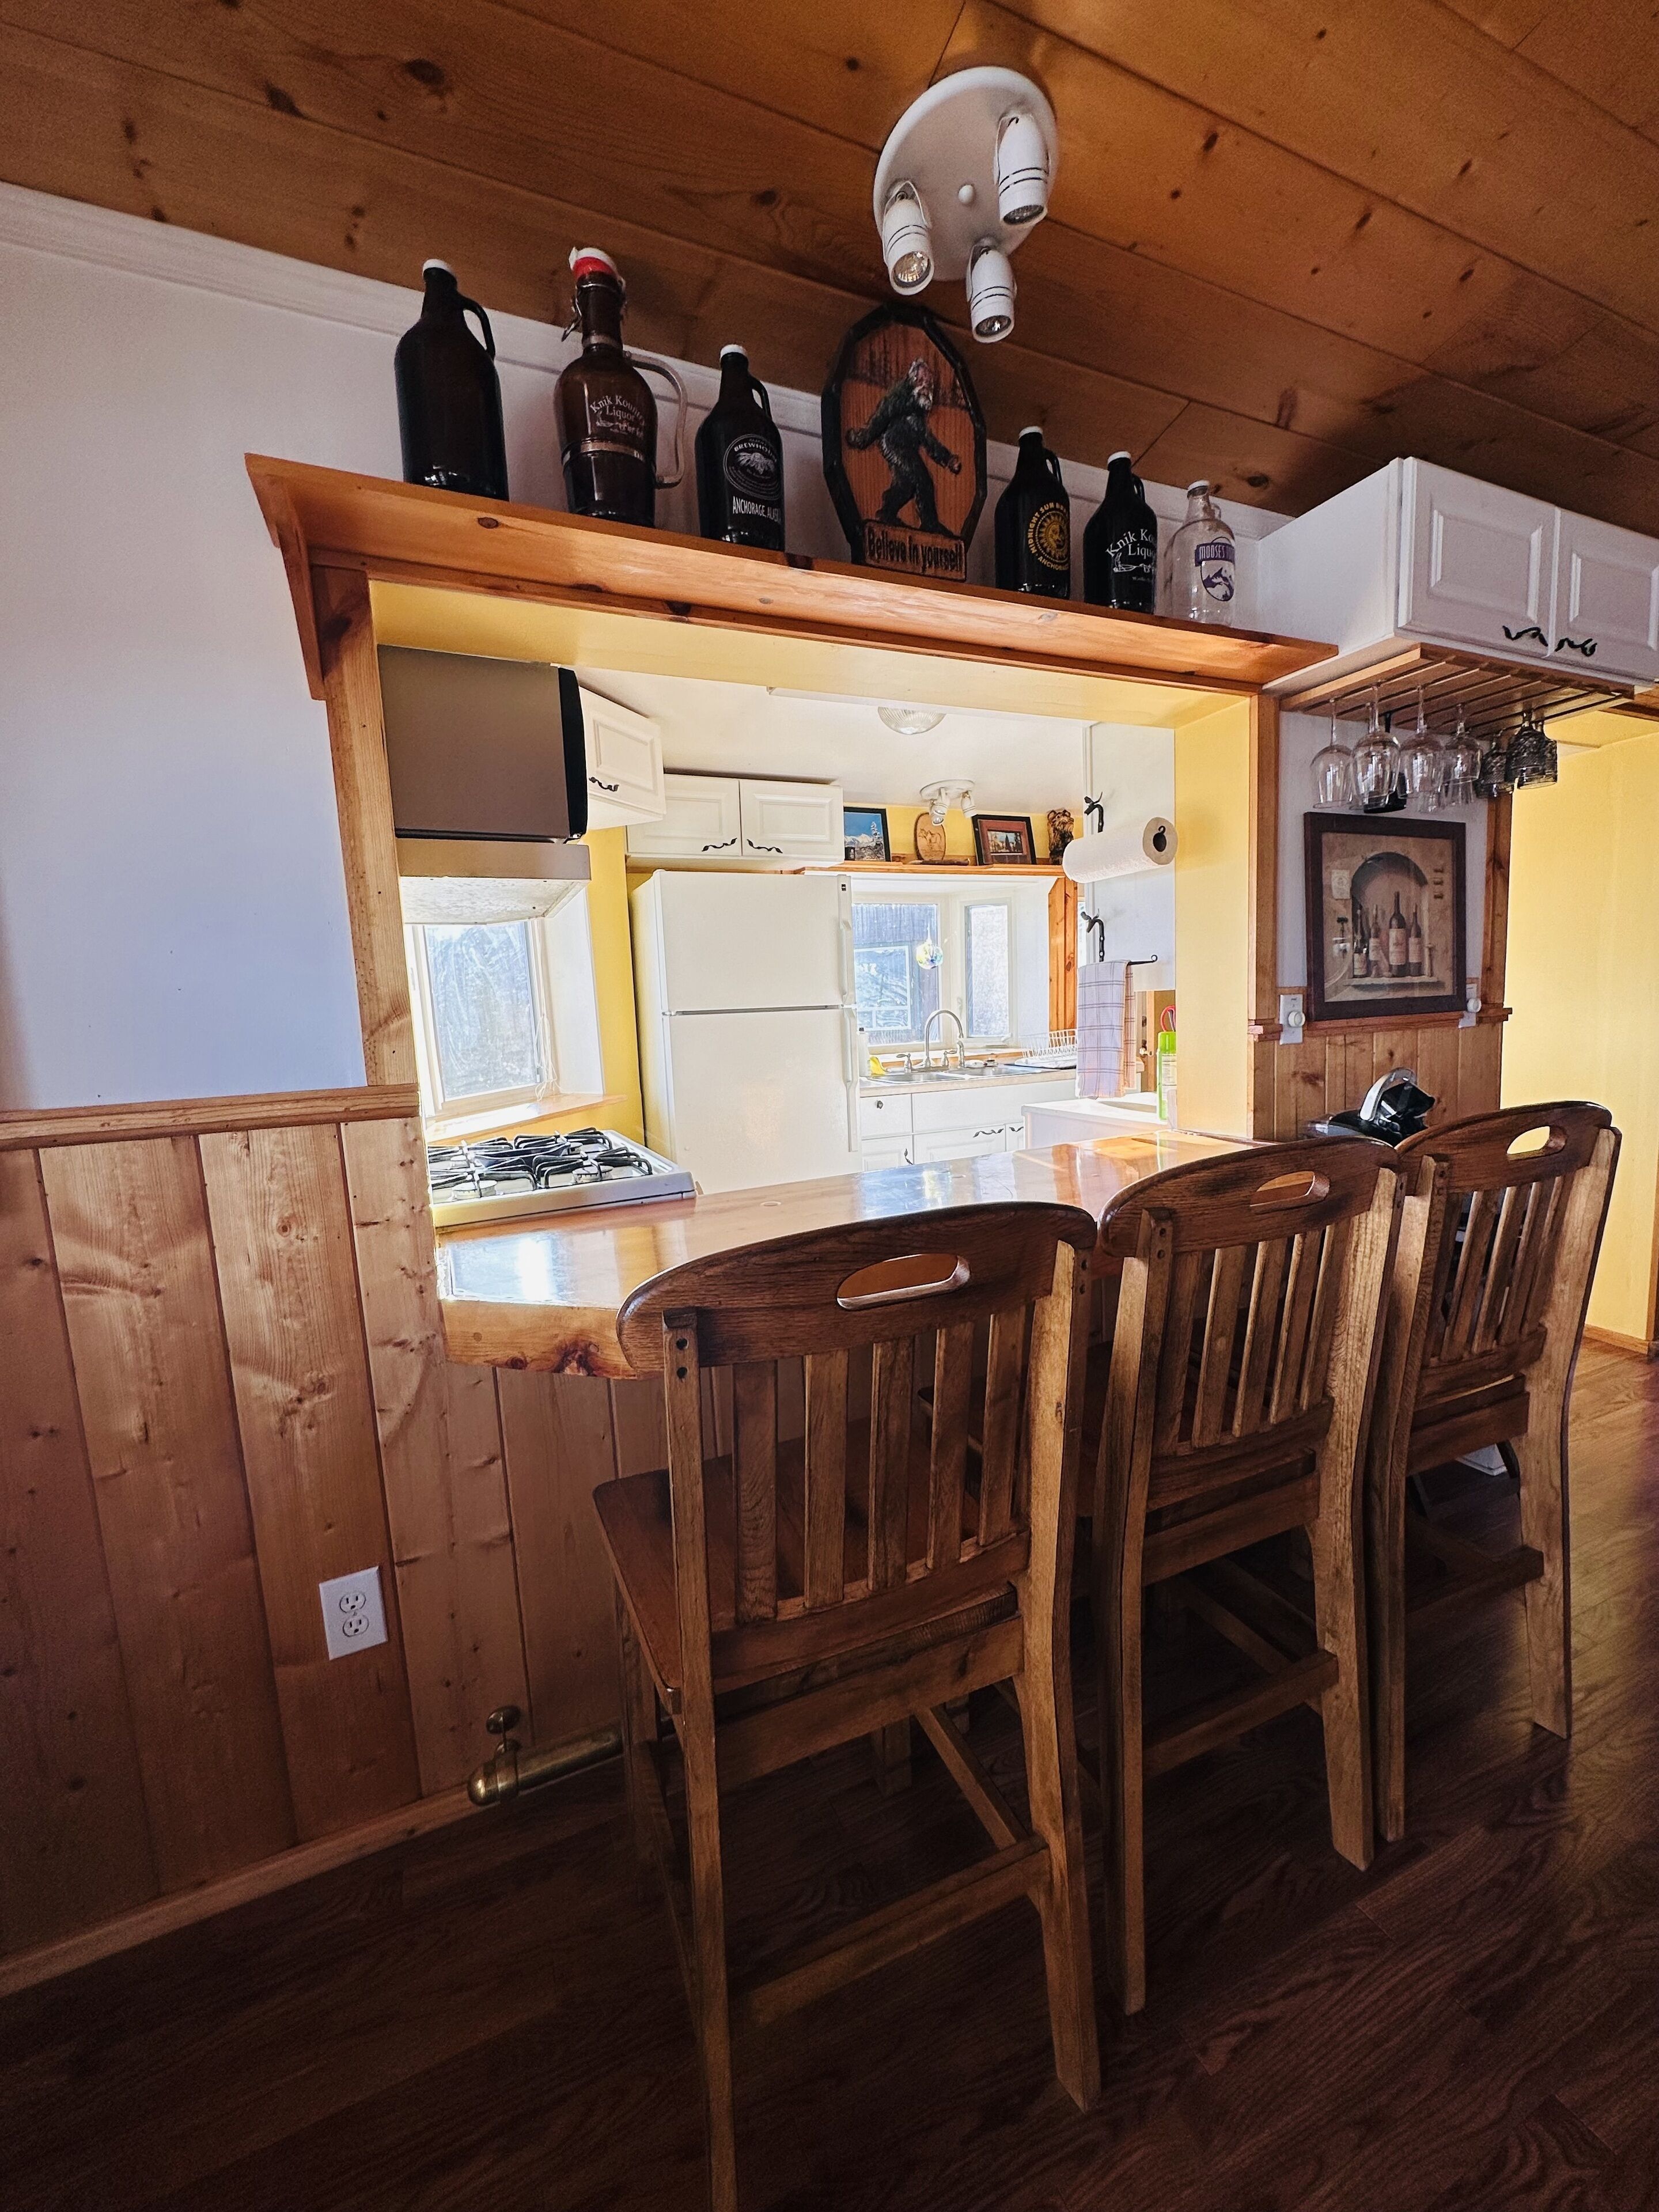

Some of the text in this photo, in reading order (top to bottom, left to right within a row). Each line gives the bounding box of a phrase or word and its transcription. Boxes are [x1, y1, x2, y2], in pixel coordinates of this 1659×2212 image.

[590, 395, 612, 413] Knik
[1028, 502, 1054, 553] MIDNIGHT SUN
[1105, 531, 1137, 558] Knik
